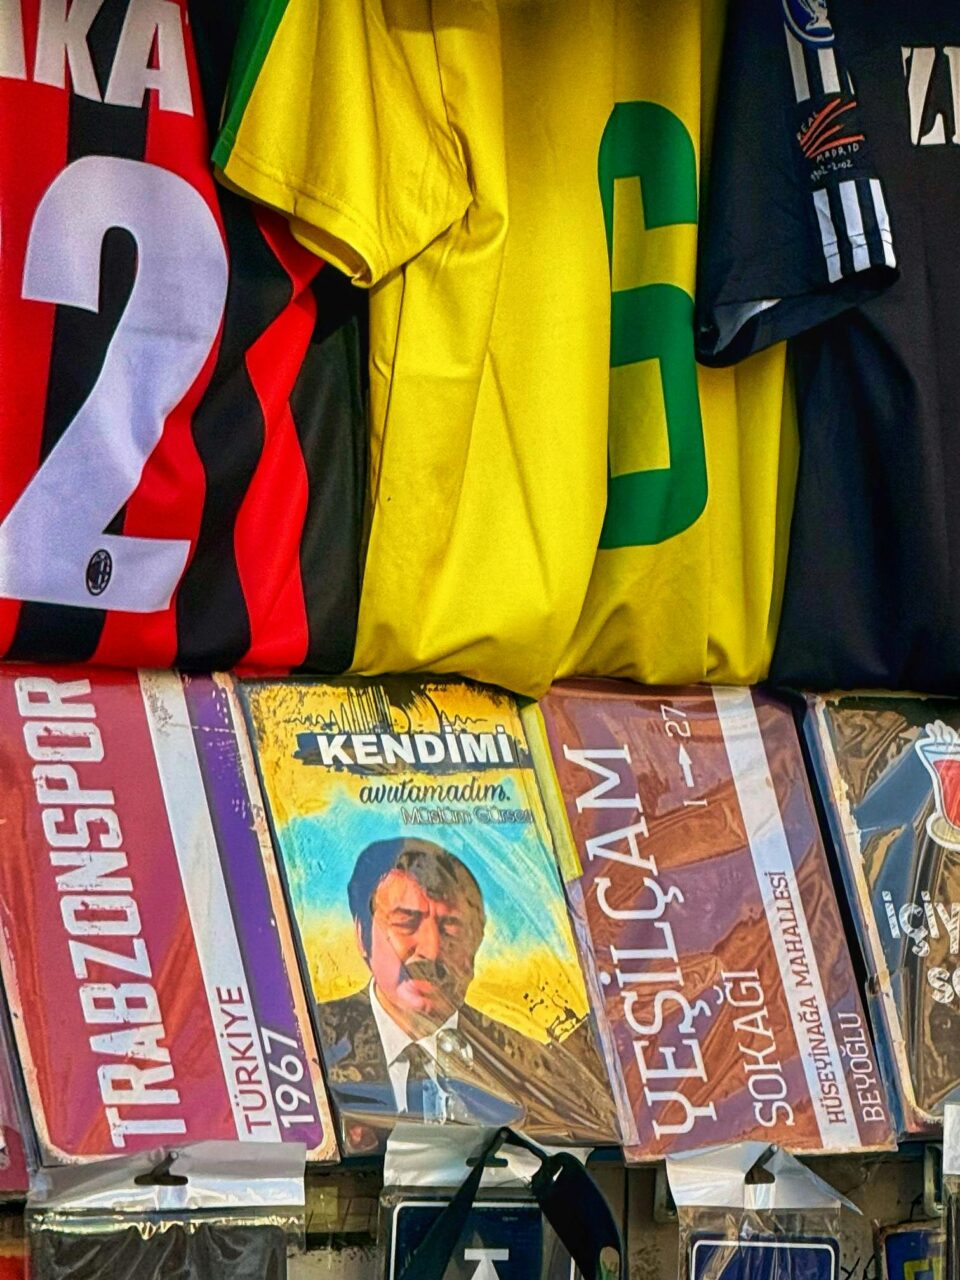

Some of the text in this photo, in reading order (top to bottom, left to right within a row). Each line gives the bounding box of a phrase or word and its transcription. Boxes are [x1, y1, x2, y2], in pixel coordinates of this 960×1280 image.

[316, 724, 514, 765] KENDİMİ
[16, 678, 187, 1148] TRABZONSPOR
[563, 744, 716, 1141] YEŞİLÇAM
[215, 986, 270, 1133] TÜRKİYE
[714, 968, 795, 1128] SOKAĞI
[763, 871, 848, 1126] HÜSEYİNAĞA MAHALLESİ
[838, 1011, 887, 1123] BEYOĞLU
[266, 1028, 314, 1129] 1967
